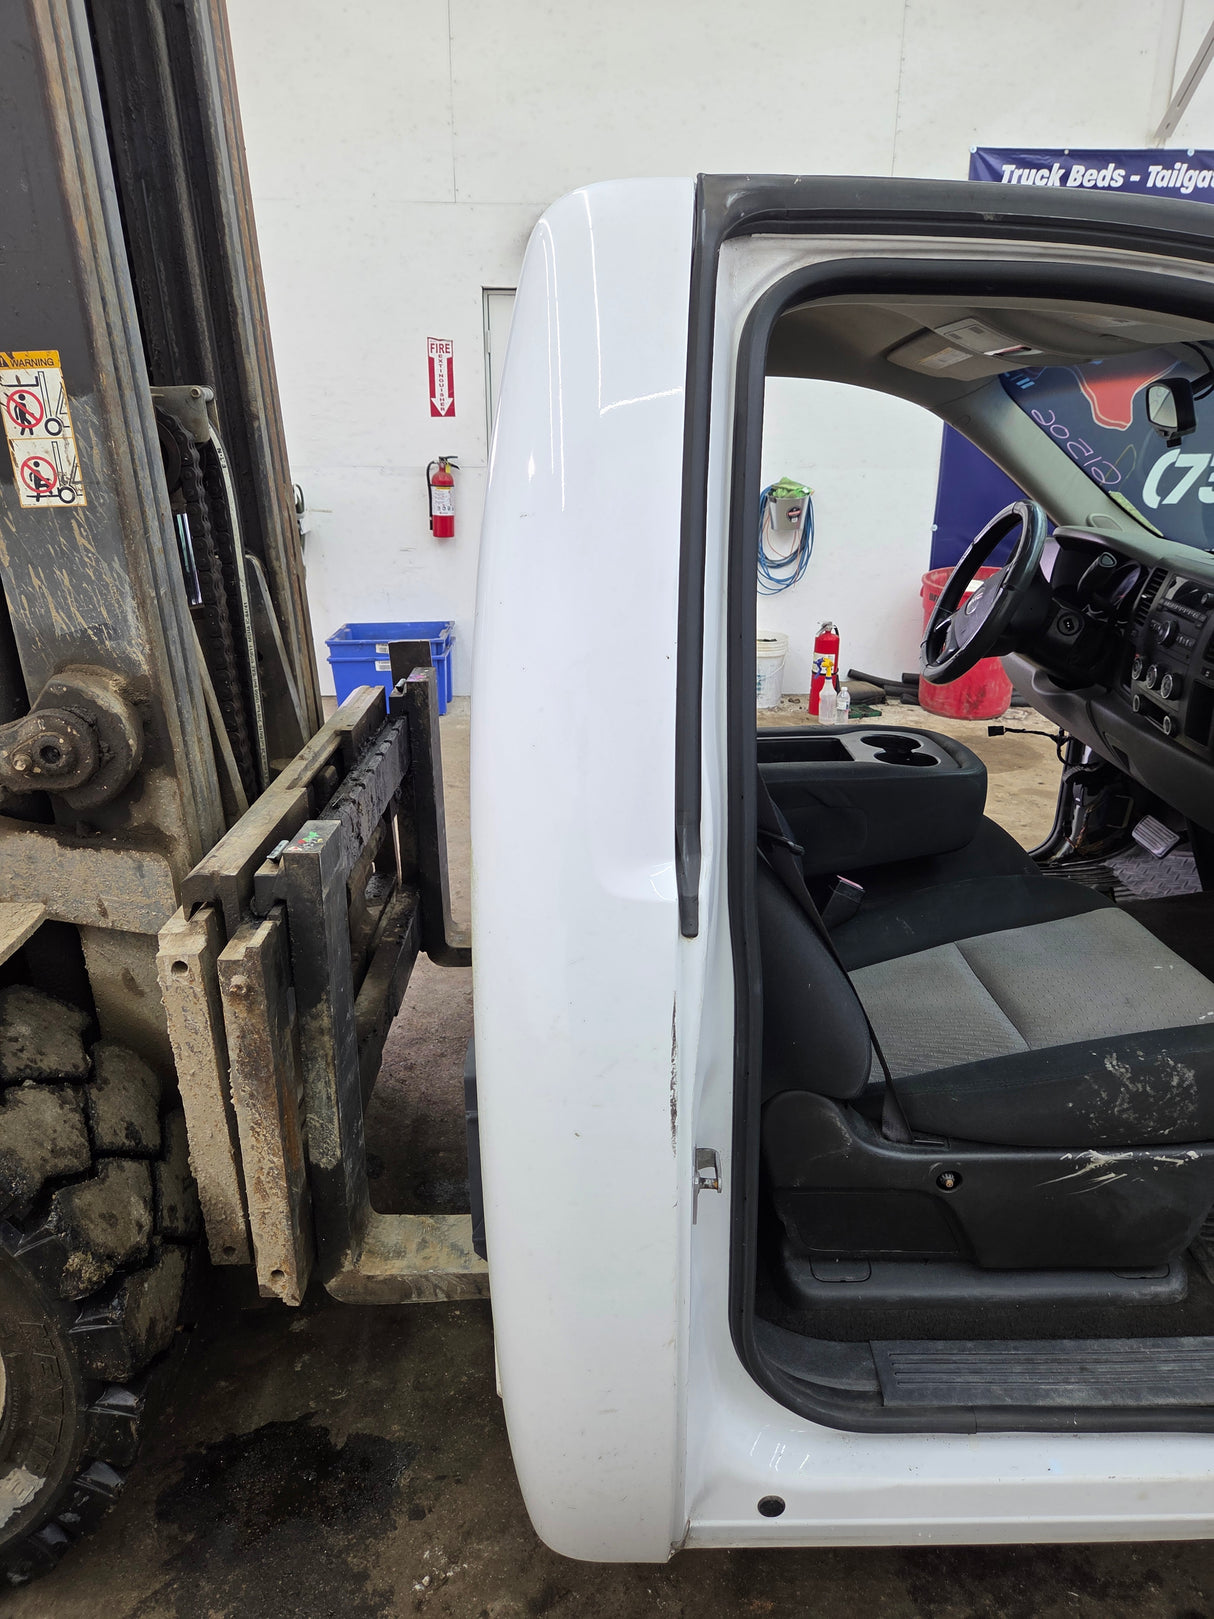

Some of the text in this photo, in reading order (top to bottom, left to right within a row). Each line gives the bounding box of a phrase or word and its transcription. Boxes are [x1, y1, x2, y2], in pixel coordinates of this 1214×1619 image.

[1001, 163, 1065, 187] Truck
[1066, 163, 1126, 188] Beds
[430, 343, 450, 353] FIRE
[10, 358, 54, 367] WARNING
